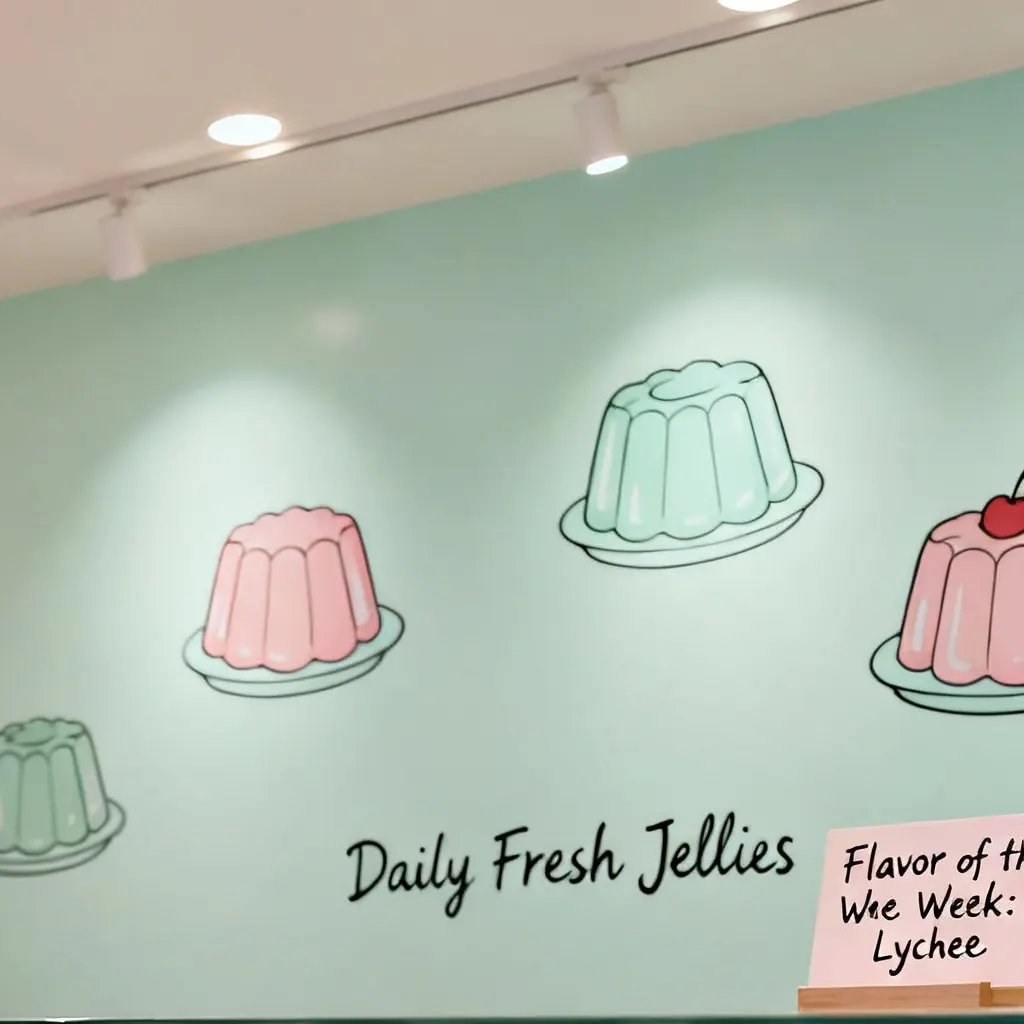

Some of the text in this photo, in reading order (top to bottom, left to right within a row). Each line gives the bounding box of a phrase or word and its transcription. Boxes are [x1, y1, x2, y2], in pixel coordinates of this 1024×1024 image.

[346, 811, 795, 919] Daily Fresh Jellies
[843, 841, 947, 884] Flavor
[956, 837, 993, 882] of
[918, 880, 1016, 920] Week:
[872, 925, 988, 977] Lychee
